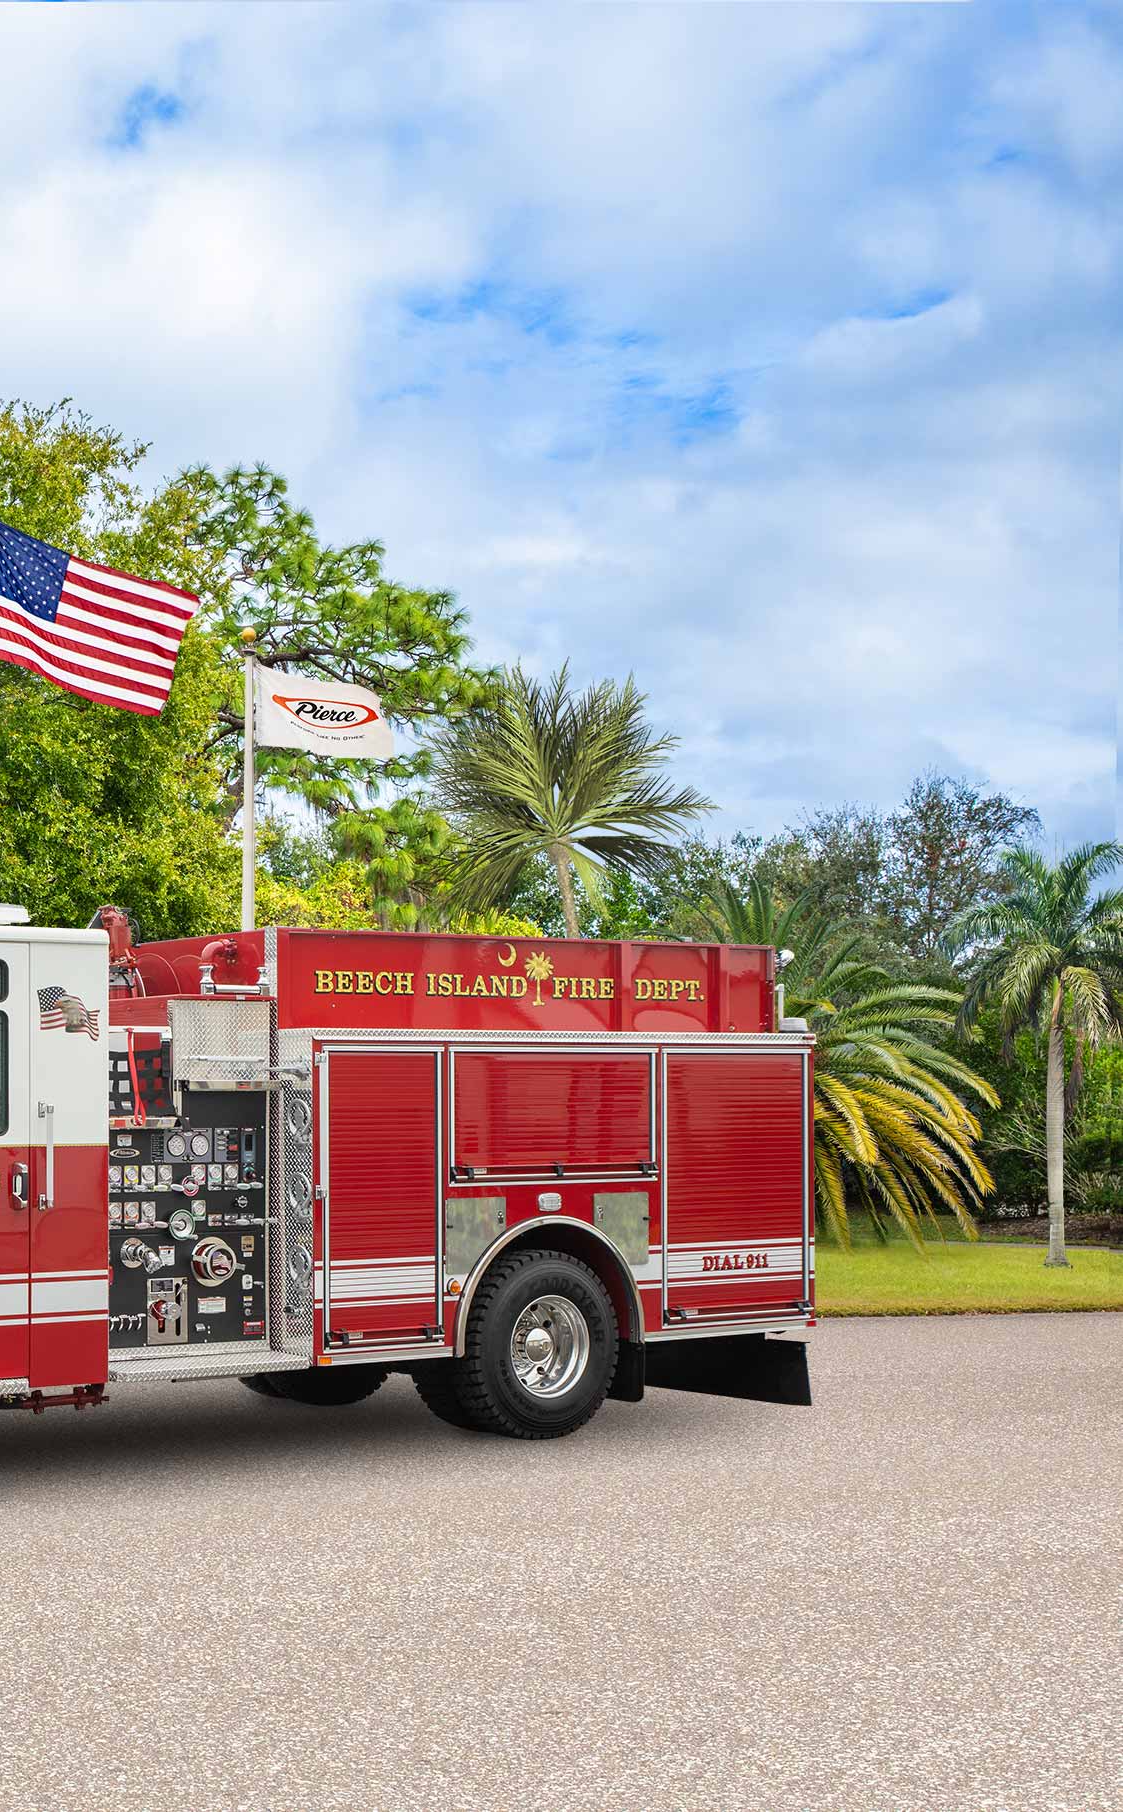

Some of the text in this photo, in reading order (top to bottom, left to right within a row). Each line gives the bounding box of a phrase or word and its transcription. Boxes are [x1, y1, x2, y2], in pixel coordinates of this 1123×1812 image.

[295, 701, 356, 722] Pierce
[313, 970, 705, 1002] BEECH ISLAND FIRE DEPT.
[702, 1252, 770, 1271] DIAL 911
